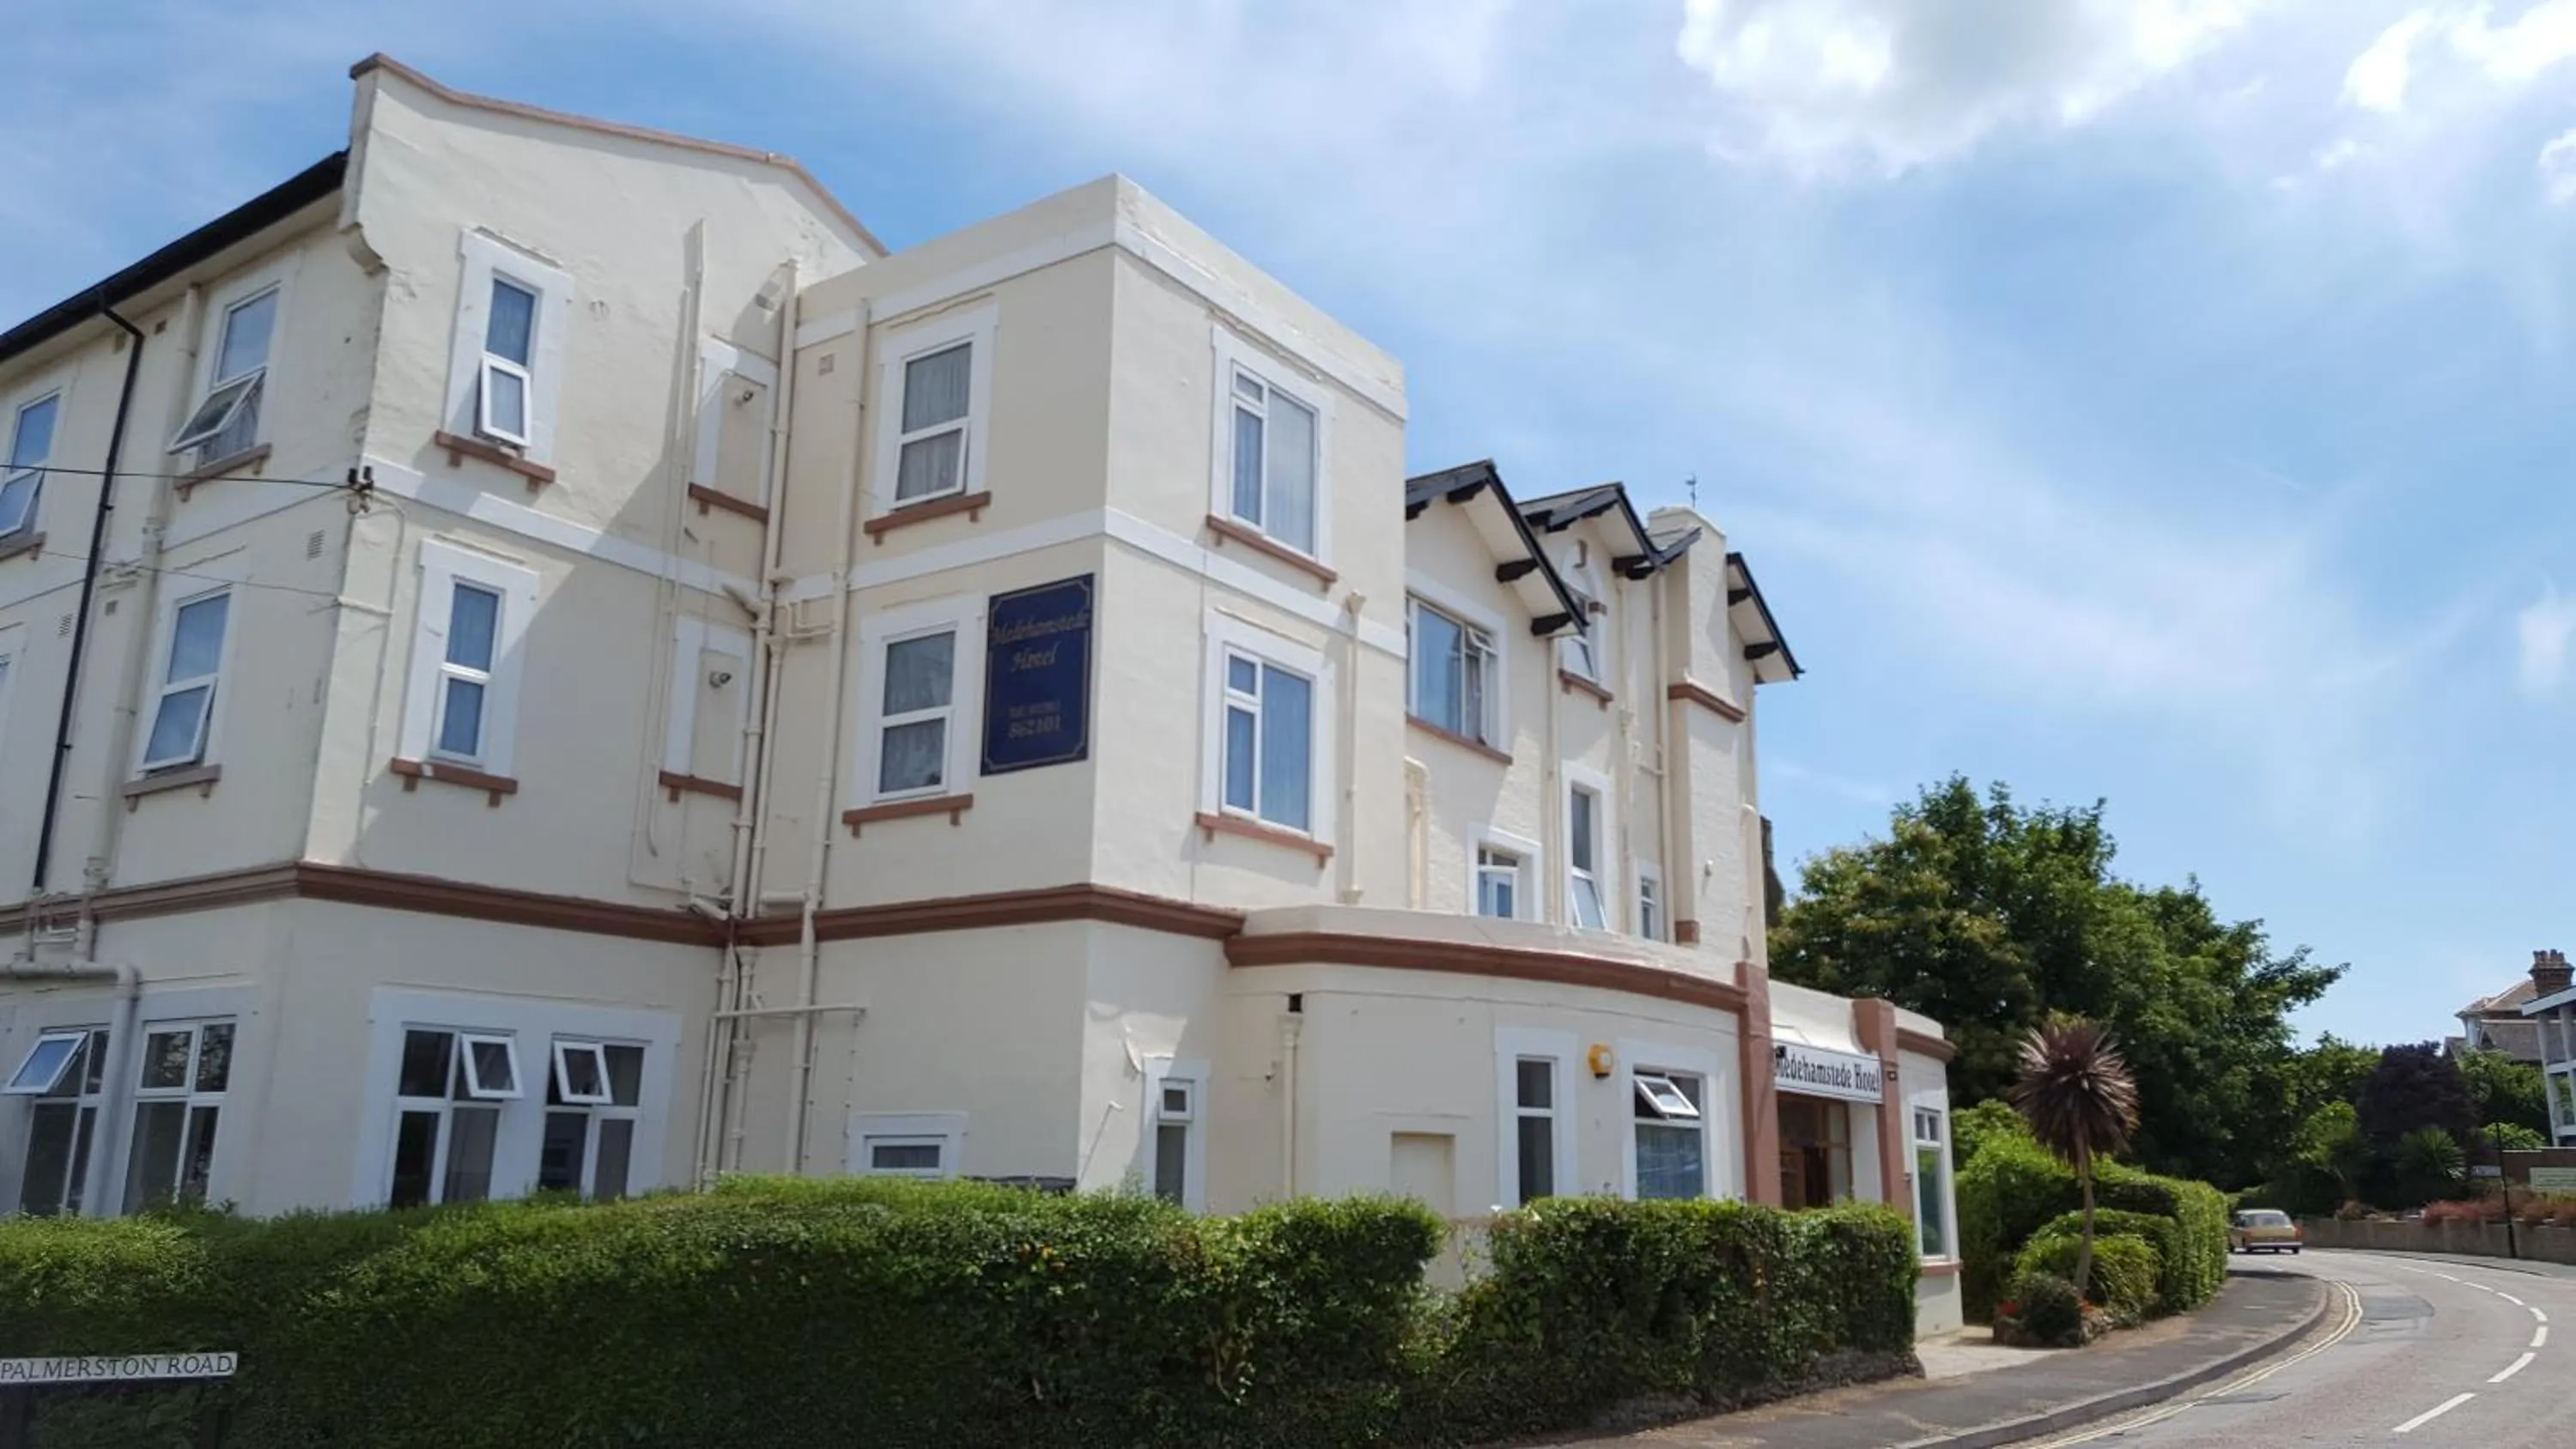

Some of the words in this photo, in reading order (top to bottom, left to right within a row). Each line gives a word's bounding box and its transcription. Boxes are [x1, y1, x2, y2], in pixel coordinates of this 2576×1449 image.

[1854, 1063, 1880, 1093] Hotel
[0, 1357, 157, 1380] PALMERSTON
[167, 1355, 234, 1374] ROAD
